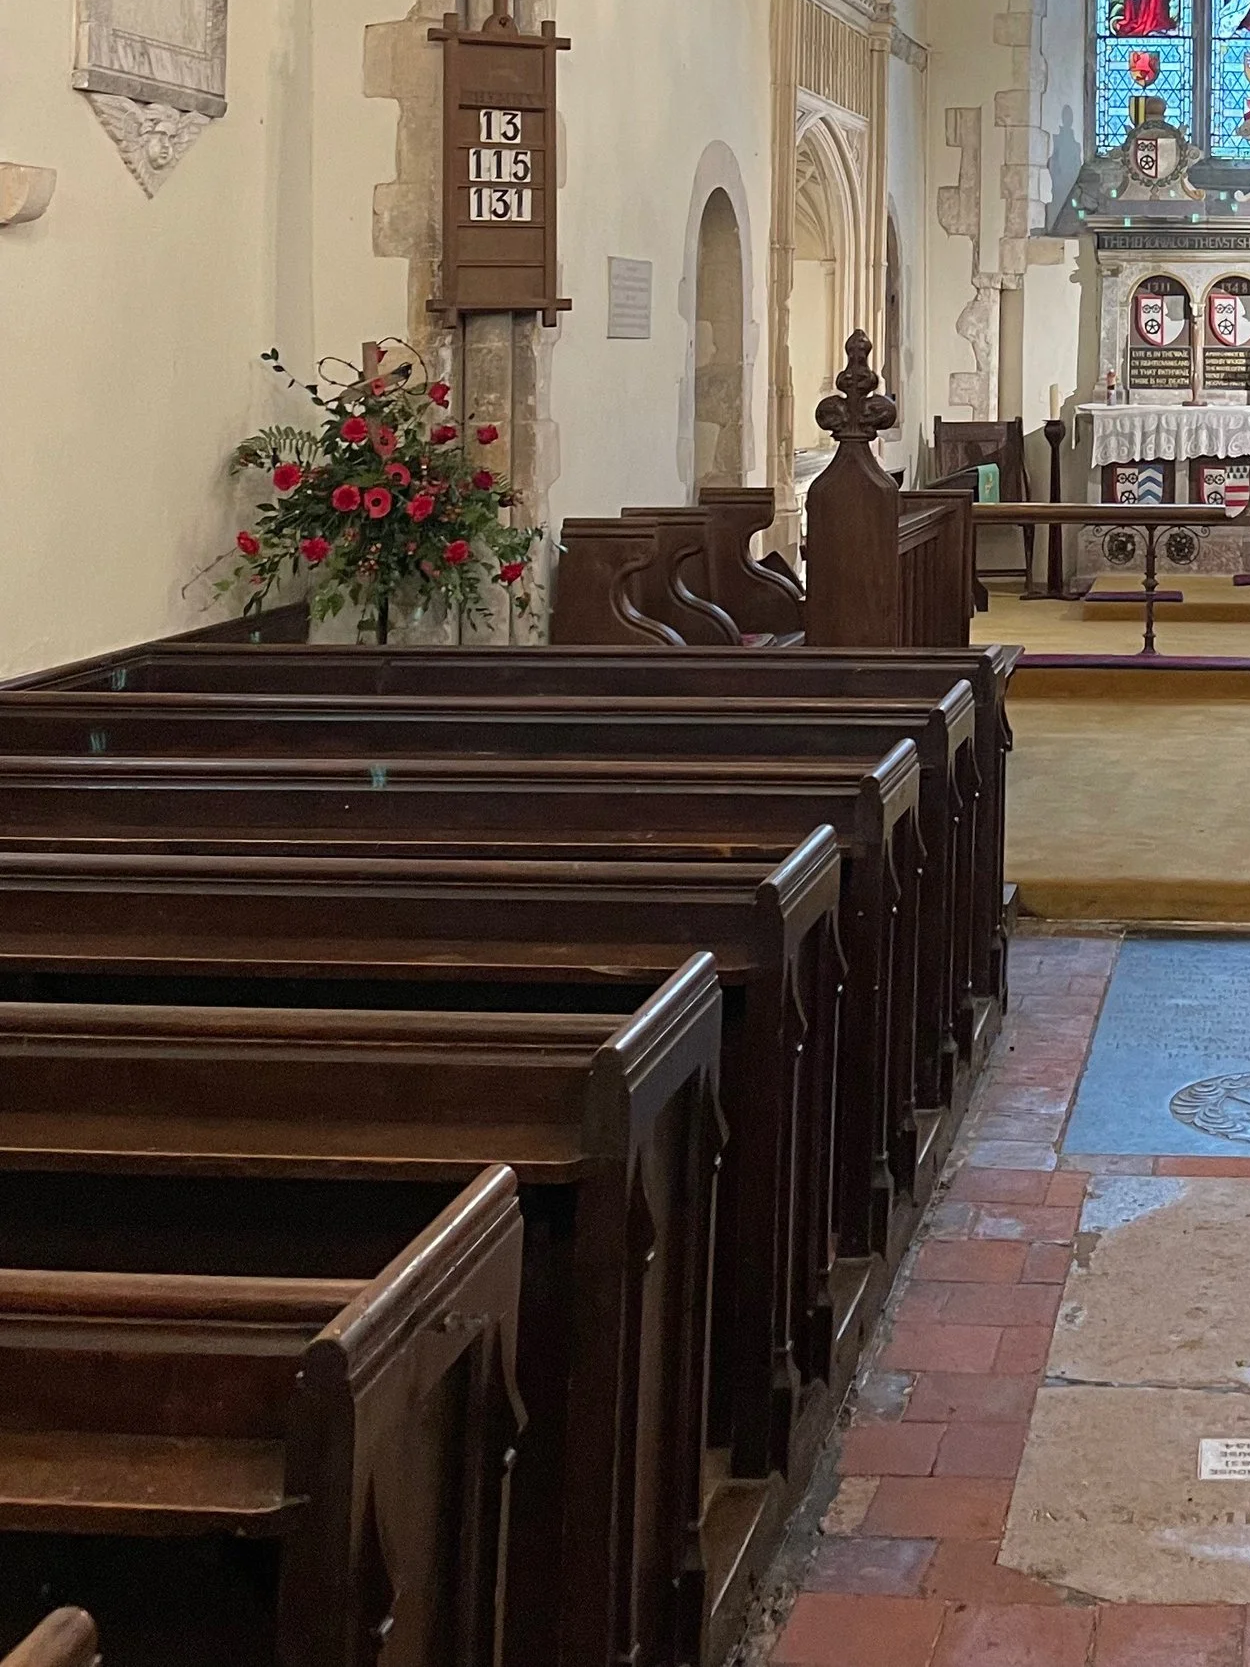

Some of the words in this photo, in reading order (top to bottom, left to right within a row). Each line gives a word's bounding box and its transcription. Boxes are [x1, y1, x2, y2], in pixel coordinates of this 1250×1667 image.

[482, 111, 521, 141] 13
[472, 149, 531, 181] 115
[473, 188, 523, 219] 131
[1194, 236, 1216, 249] THE
